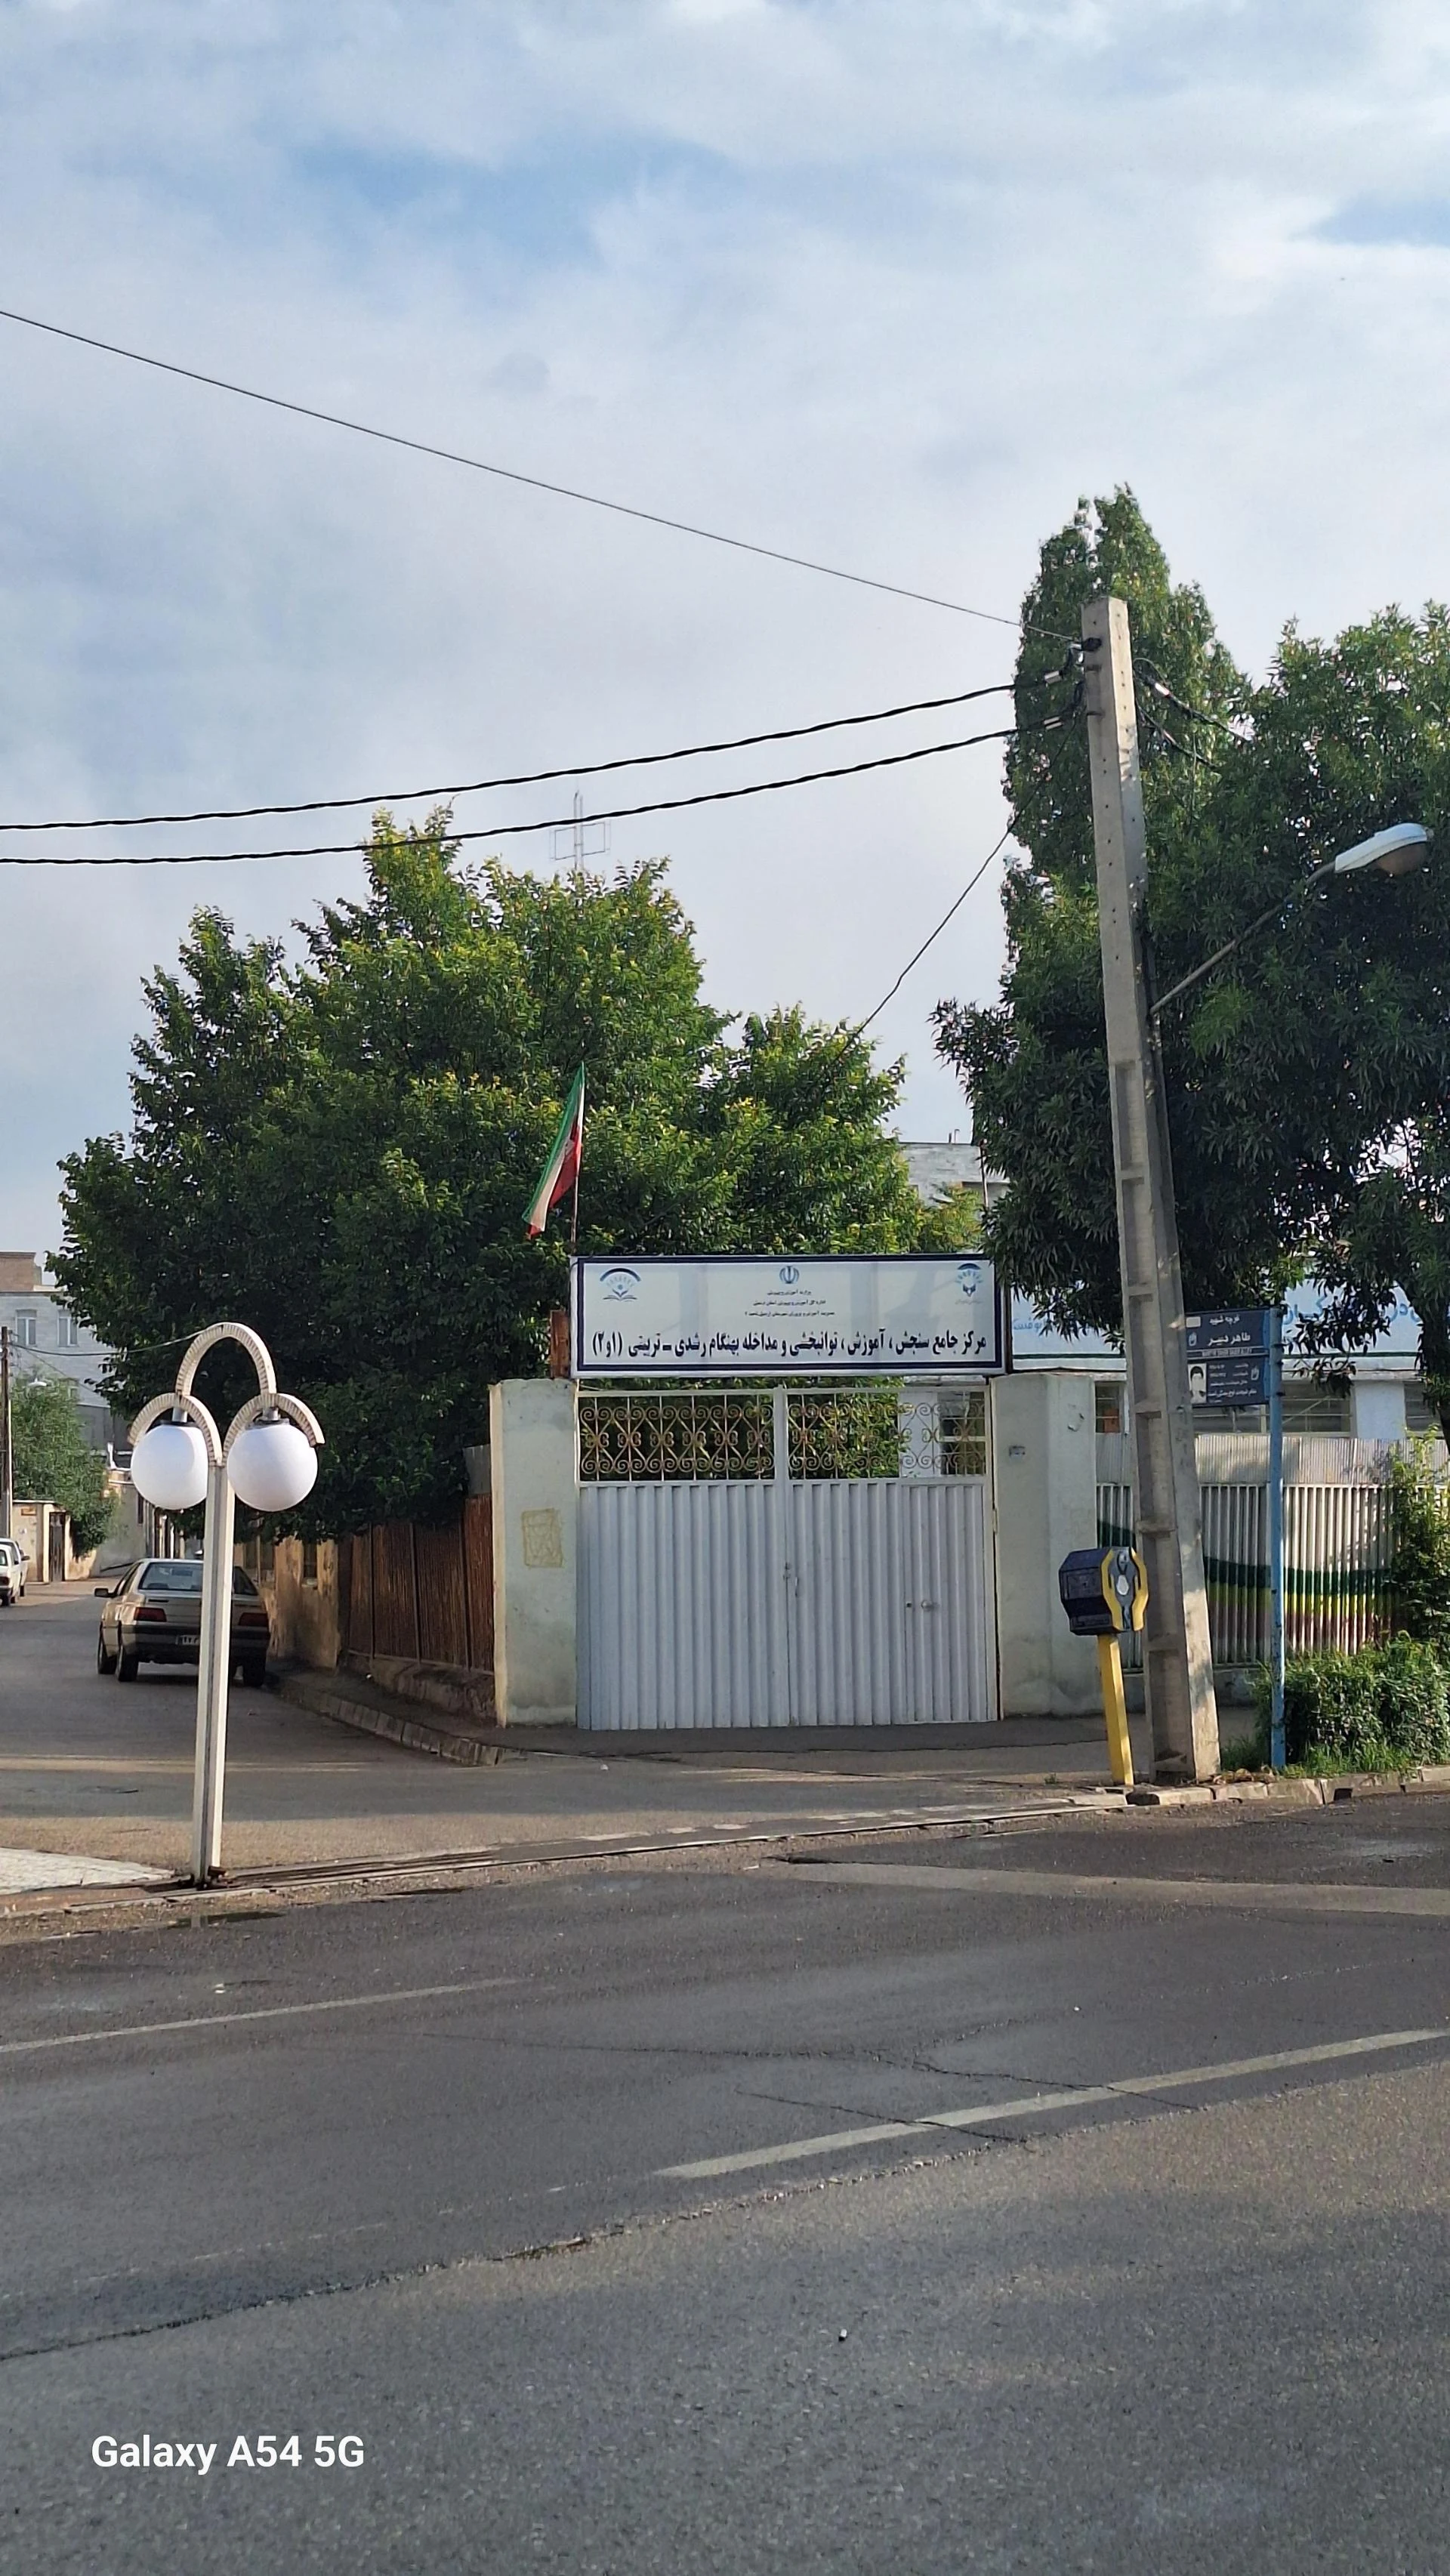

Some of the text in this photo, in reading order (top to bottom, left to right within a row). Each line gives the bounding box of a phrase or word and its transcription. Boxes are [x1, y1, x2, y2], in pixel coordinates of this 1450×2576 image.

[628, 1332, 662, 1357] تربیتی
[674, 1331, 706, 1357] رشدی
[742, 1331, 779, 1351] مداخله
[780, 1339, 787, 1357] و
[789, 1330, 838, 1357] توانبخشی
[932, 1329, 958, 1356] جامع
[961, 1330, 986, 1356] مرکز
[1230, 1331, 1251, 1345] طاهر
